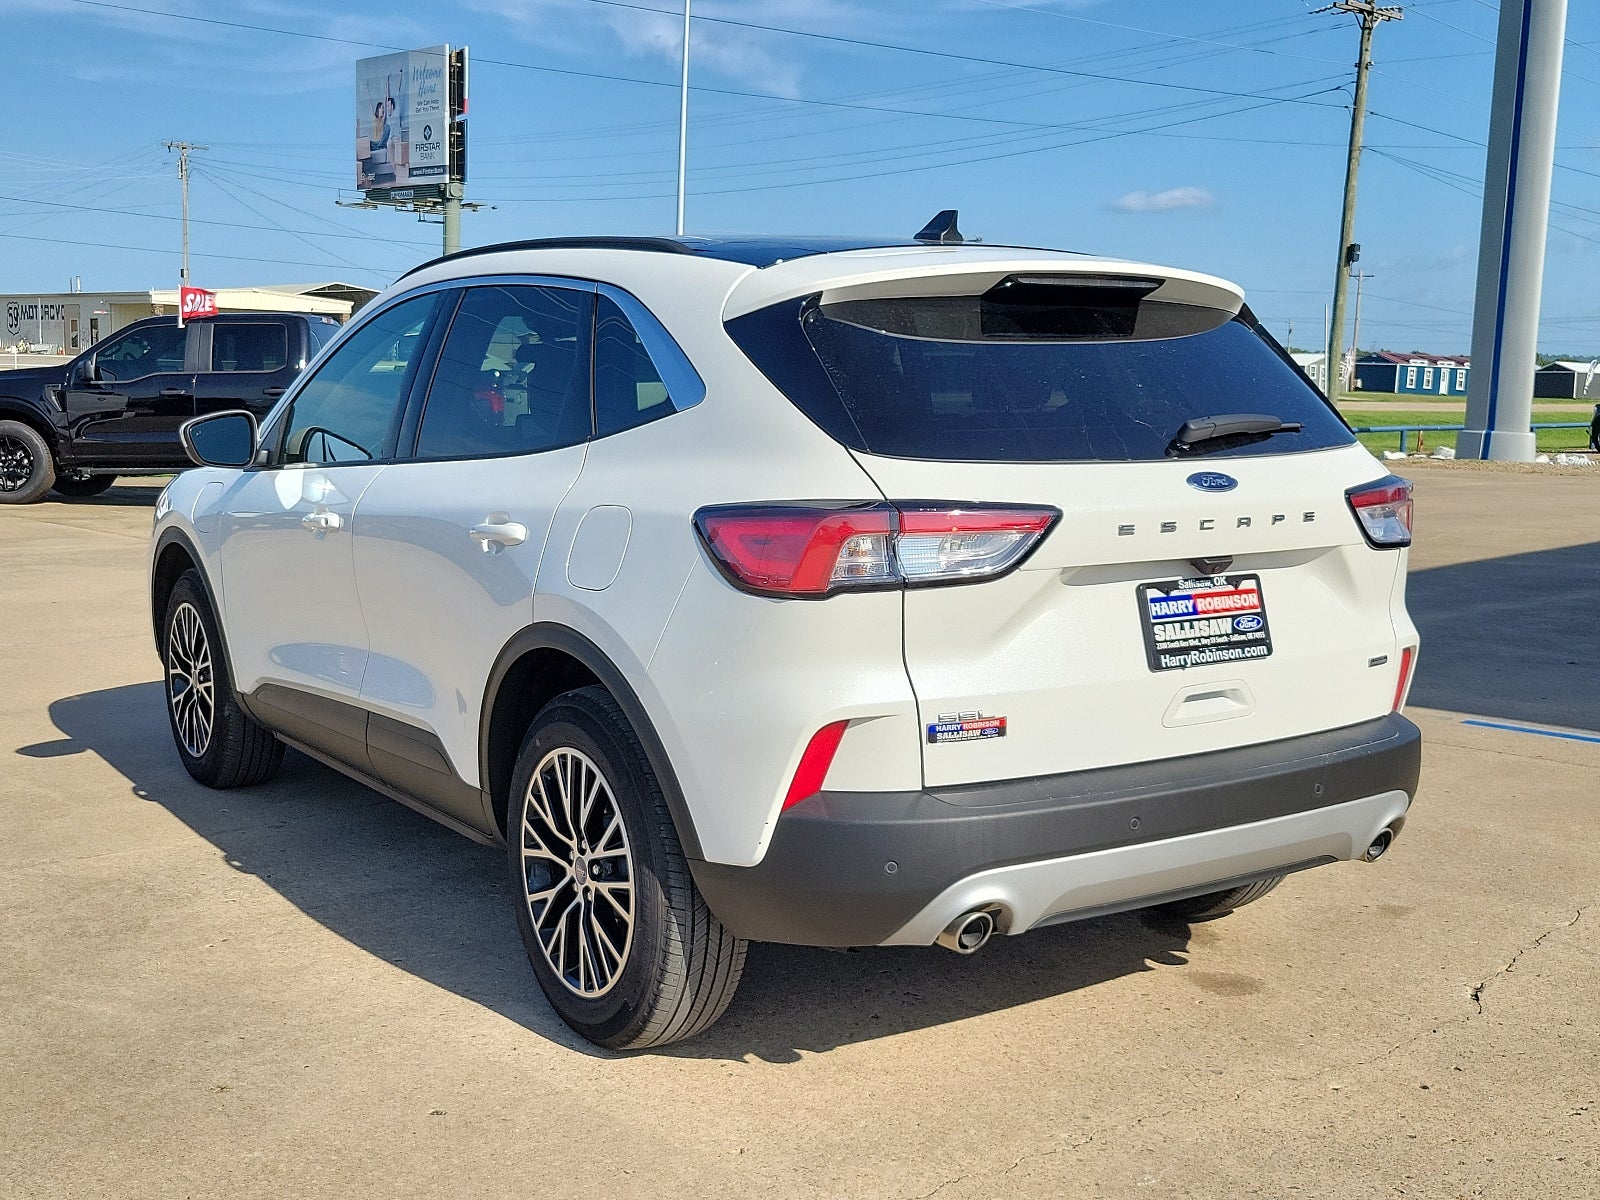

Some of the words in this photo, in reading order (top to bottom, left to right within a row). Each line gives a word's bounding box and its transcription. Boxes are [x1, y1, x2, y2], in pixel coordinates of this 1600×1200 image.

[415, 141, 441, 153] FIRSTAR
[420, 152, 435, 161] BANK
[183, 293, 214, 313] SALE
[8, 306, 19, 328] 59
[1118, 511, 1315, 536] ESCAPE
[1213, 576, 1228, 586] OK
[1150, 600, 1194, 616] HARRY
[1197, 594, 1259, 612] ROBINSON
[1154, 618, 1233, 641] SALLISAW
[1161, 646, 1267, 667] HarryRobinson.com
[935, 723, 962, 732] HARRY
[962, 719, 1000, 730] ROBINSON
[936, 729, 982, 740] SALLISAW
